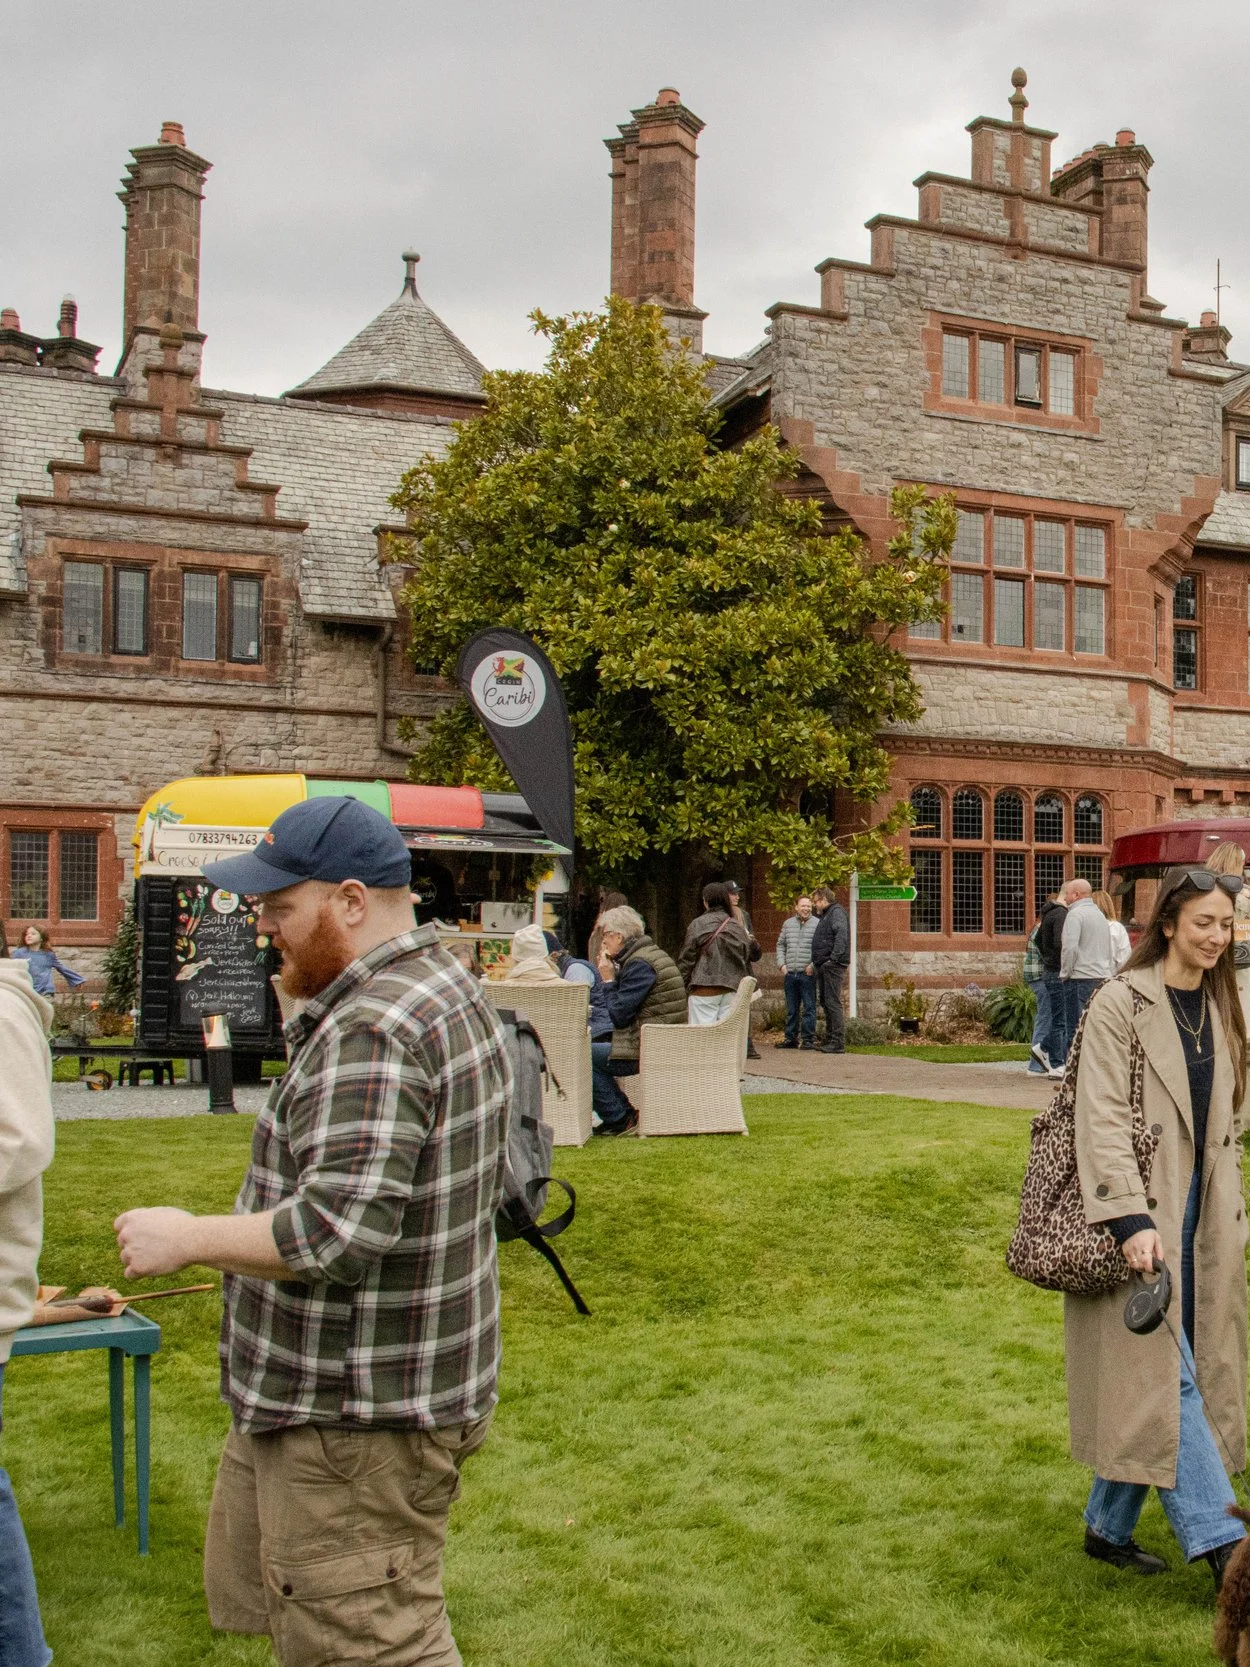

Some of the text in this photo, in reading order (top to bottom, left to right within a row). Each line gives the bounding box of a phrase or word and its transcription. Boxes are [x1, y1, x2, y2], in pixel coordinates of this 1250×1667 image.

[484, 687, 534, 708] Caribi
[188, 832, 258, 846] 07833794263
[201, 913, 227, 926] Sold
